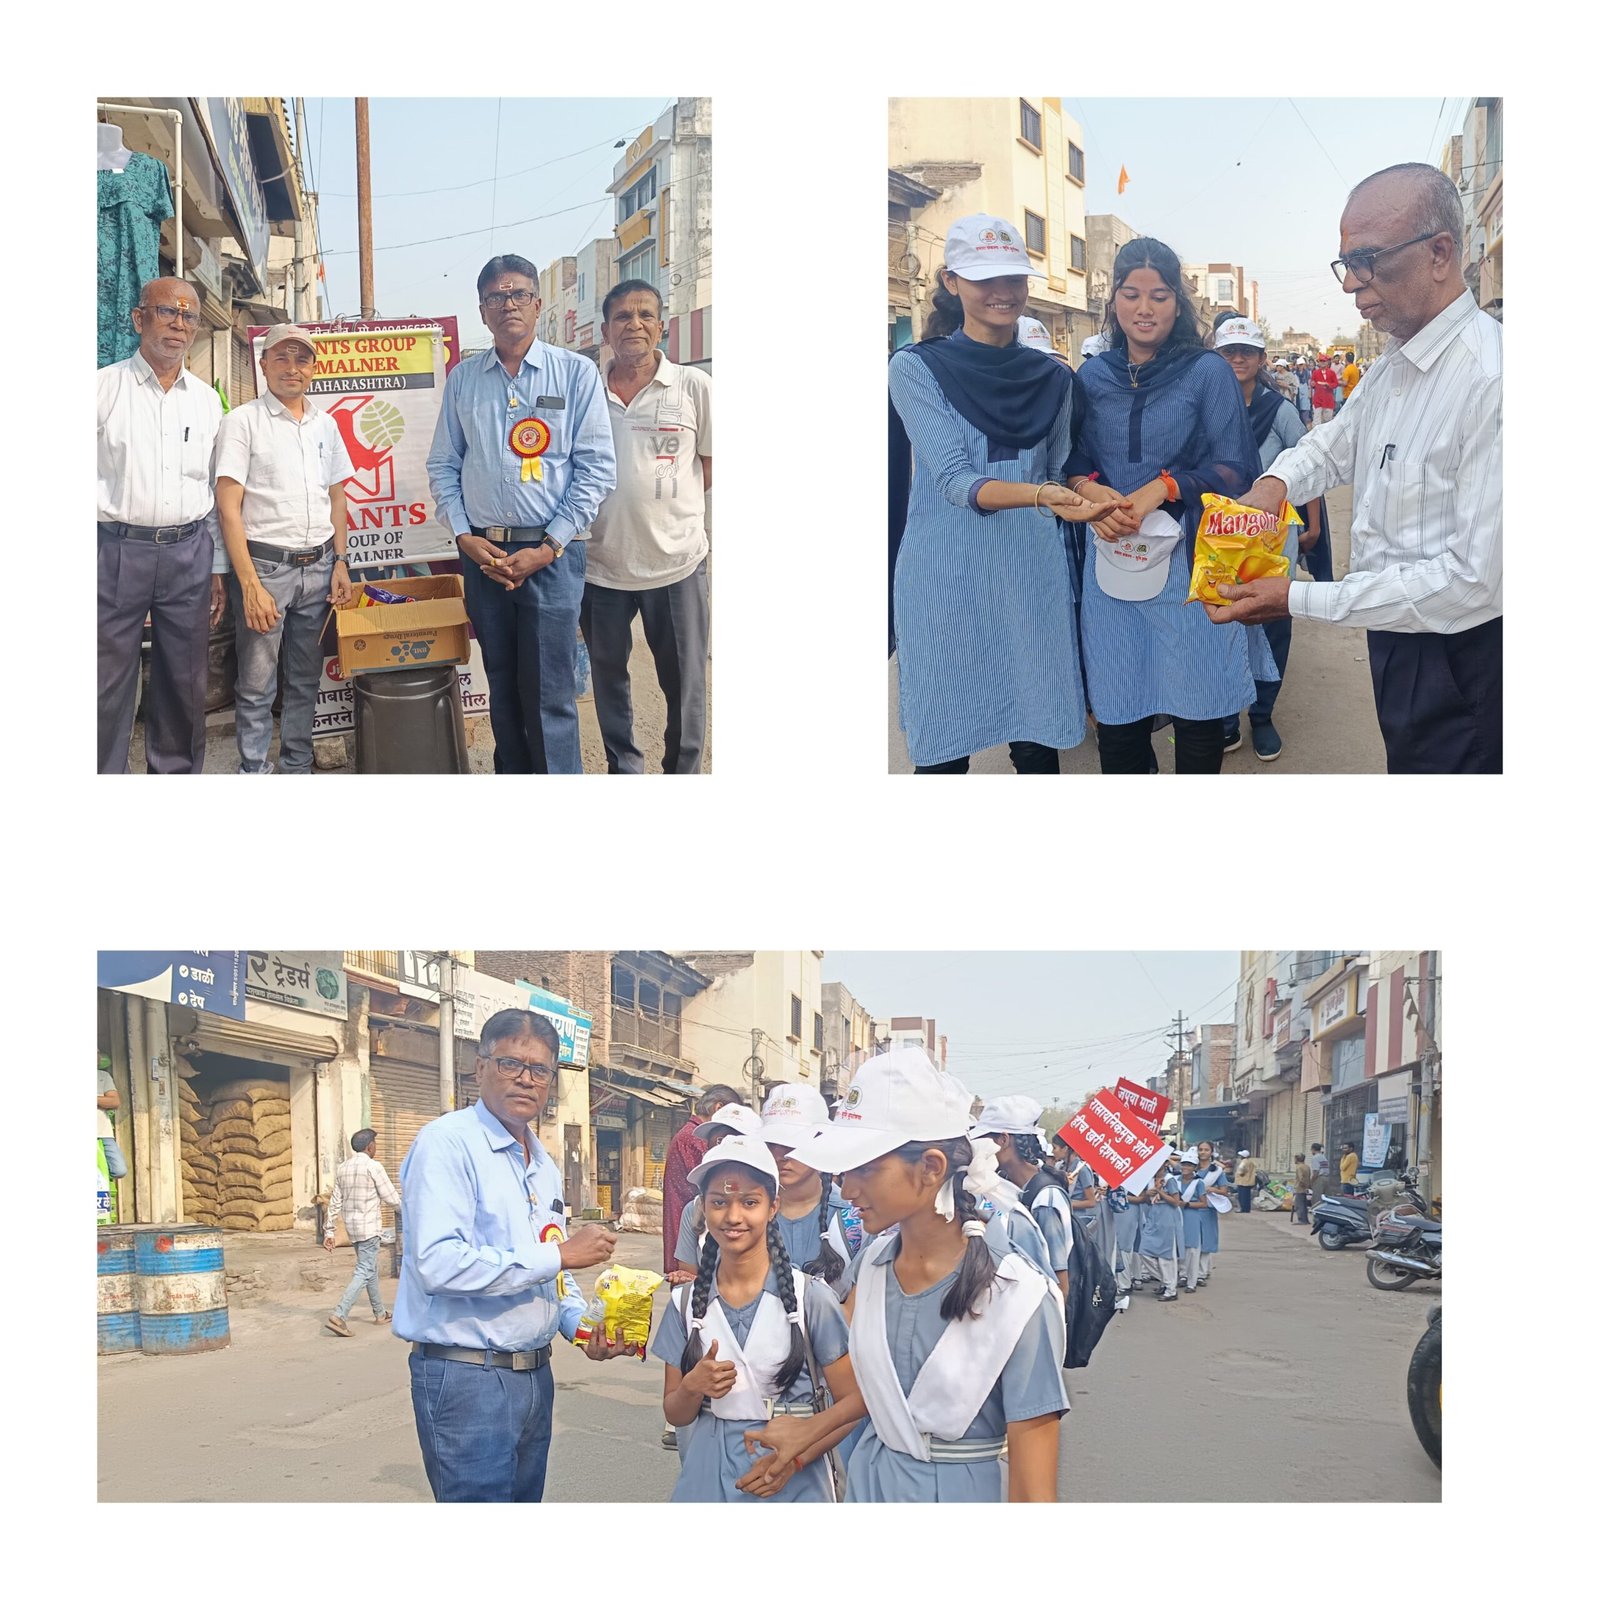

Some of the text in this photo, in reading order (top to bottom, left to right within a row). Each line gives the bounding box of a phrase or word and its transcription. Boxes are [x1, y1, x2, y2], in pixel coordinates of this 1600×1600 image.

[354, 337, 417, 353] GROUP
[314, 357, 400, 374] MALNER
[346, 531, 403, 548] OUP OF
[329, 663, 340, 676] Ji
[190, 967, 215, 985] डाळी
[272, 956, 311, 989] ट्रेडर्स
[1139, 1097, 1158, 1114] माती
[1070, 1115, 1089, 1134] हीच
[1085, 1128, 1105, 1147] खरी
[1132, 1138, 1154, 1160] शेती
